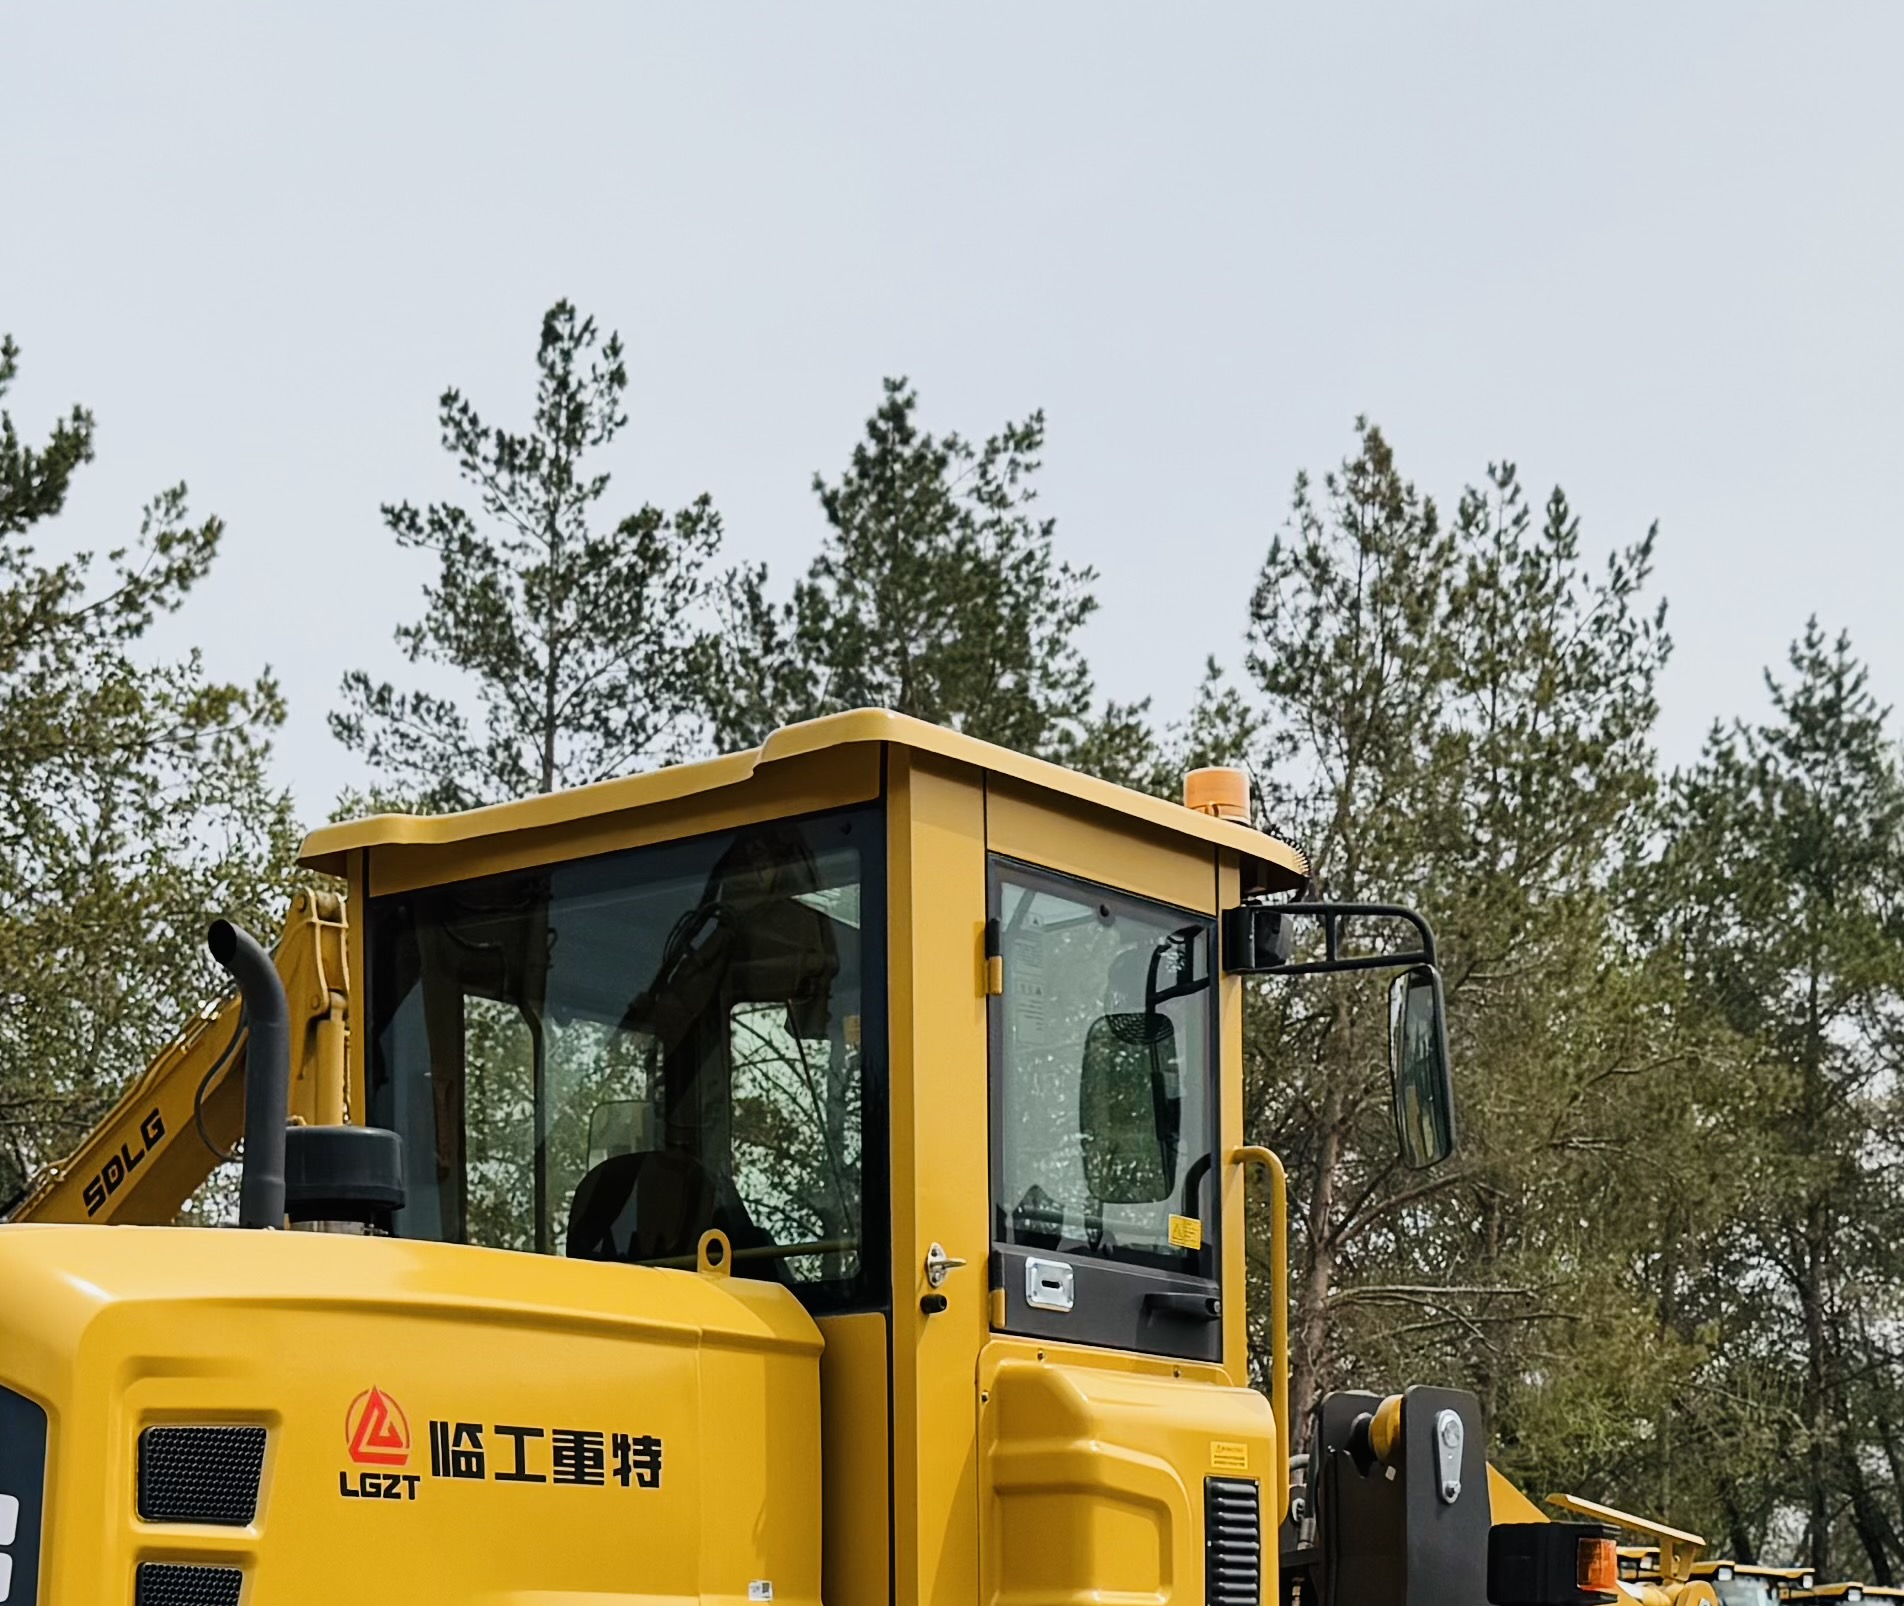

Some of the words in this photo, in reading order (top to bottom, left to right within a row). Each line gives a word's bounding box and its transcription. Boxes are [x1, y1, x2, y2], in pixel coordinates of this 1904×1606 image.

[83, 1107, 165, 1217] SDLG
[339, 1471, 421, 1500] LGZT
[429, 1420, 662, 1488] 临工重特
